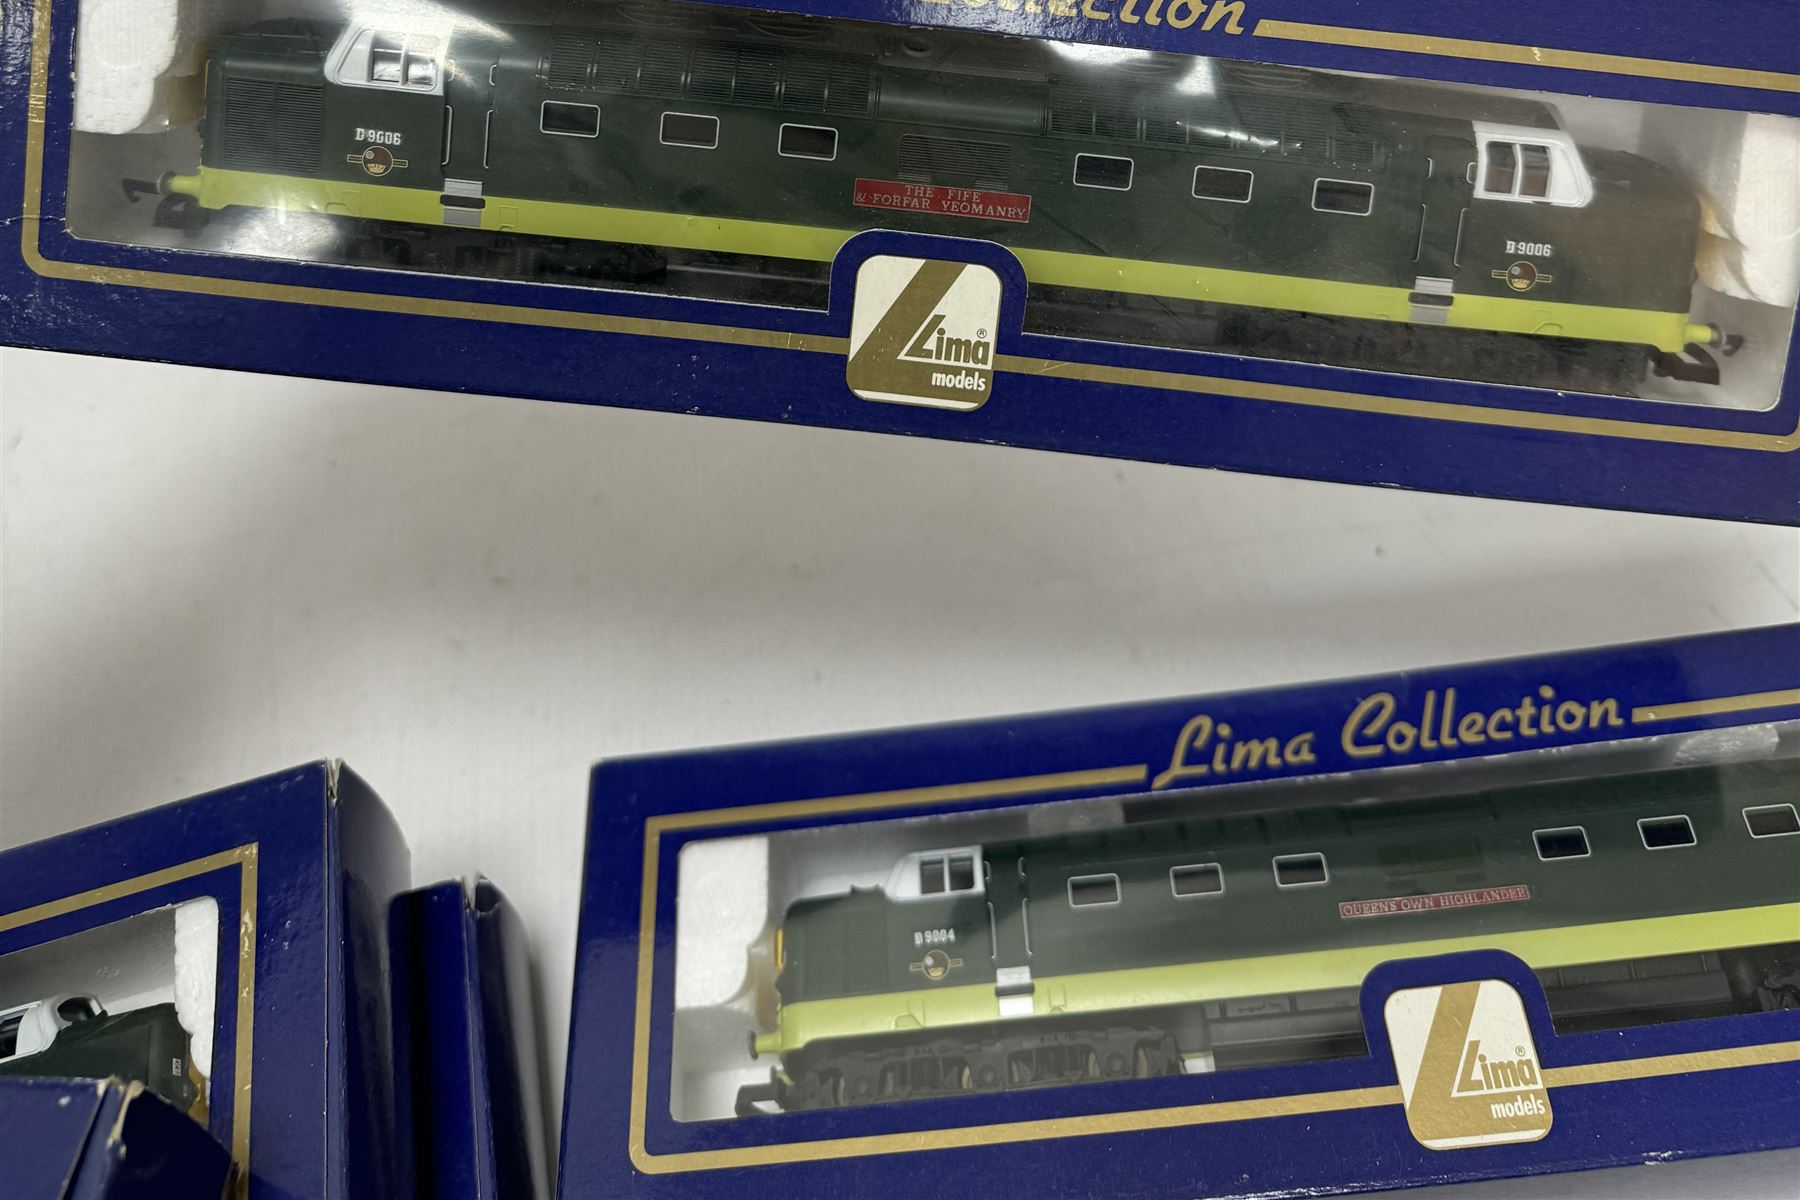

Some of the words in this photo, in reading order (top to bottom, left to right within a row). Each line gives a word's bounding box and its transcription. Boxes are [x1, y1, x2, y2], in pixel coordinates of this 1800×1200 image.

[855, 192, 866, 203] &
[872, 194, 931, 210] FORFAR
[941, 200, 1026, 219] YEOMANRY
[905, 184, 935, 198] THE
[948, 189, 982, 203] FIFE
[904, 314, 991, 366] Lima
[931, 370, 986, 392] models
[1151, 714, 1315, 790] Lima
[1340, 684, 1623, 757] Collection
[1400, 897, 1434, 911] OWN
[1456, 1039, 1539, 1093] Lima
[1490, 1093, 1546, 1119] models
